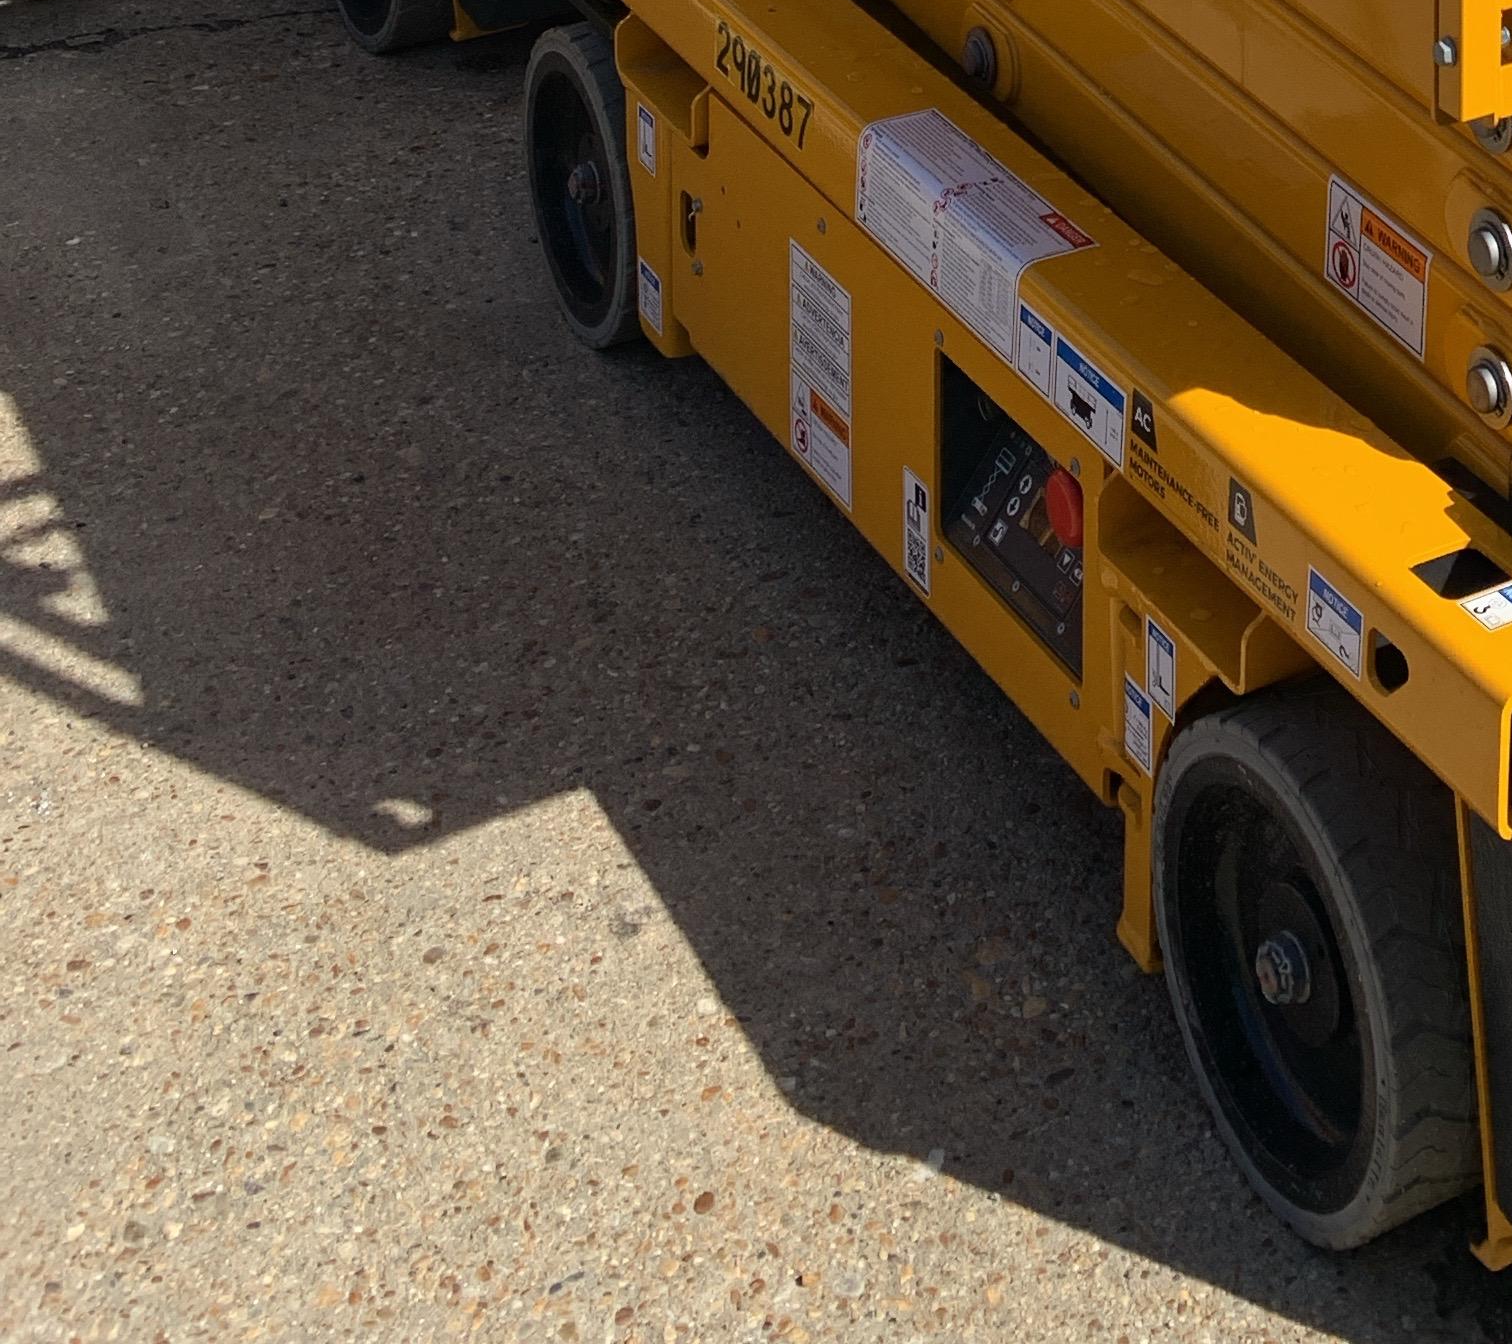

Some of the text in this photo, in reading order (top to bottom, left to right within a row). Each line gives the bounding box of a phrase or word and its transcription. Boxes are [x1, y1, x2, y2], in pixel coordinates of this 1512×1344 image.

[715, 20, 815, 150] 290387
[1377, 228, 1421, 275] WARNING
[1079, 361, 1101, 390] NOTICE
[1134, 405, 1152, 433] AC
[1129, 459, 1166, 501] MOTORS
[1129, 437, 1221, 534] MAINTENANCE-FREE
[1225, 548, 1297, 622] MANAGEMENT
[1258, 558, 1299, 606] ENERGY
[1323, 587, 1350, 620] NOTICE
